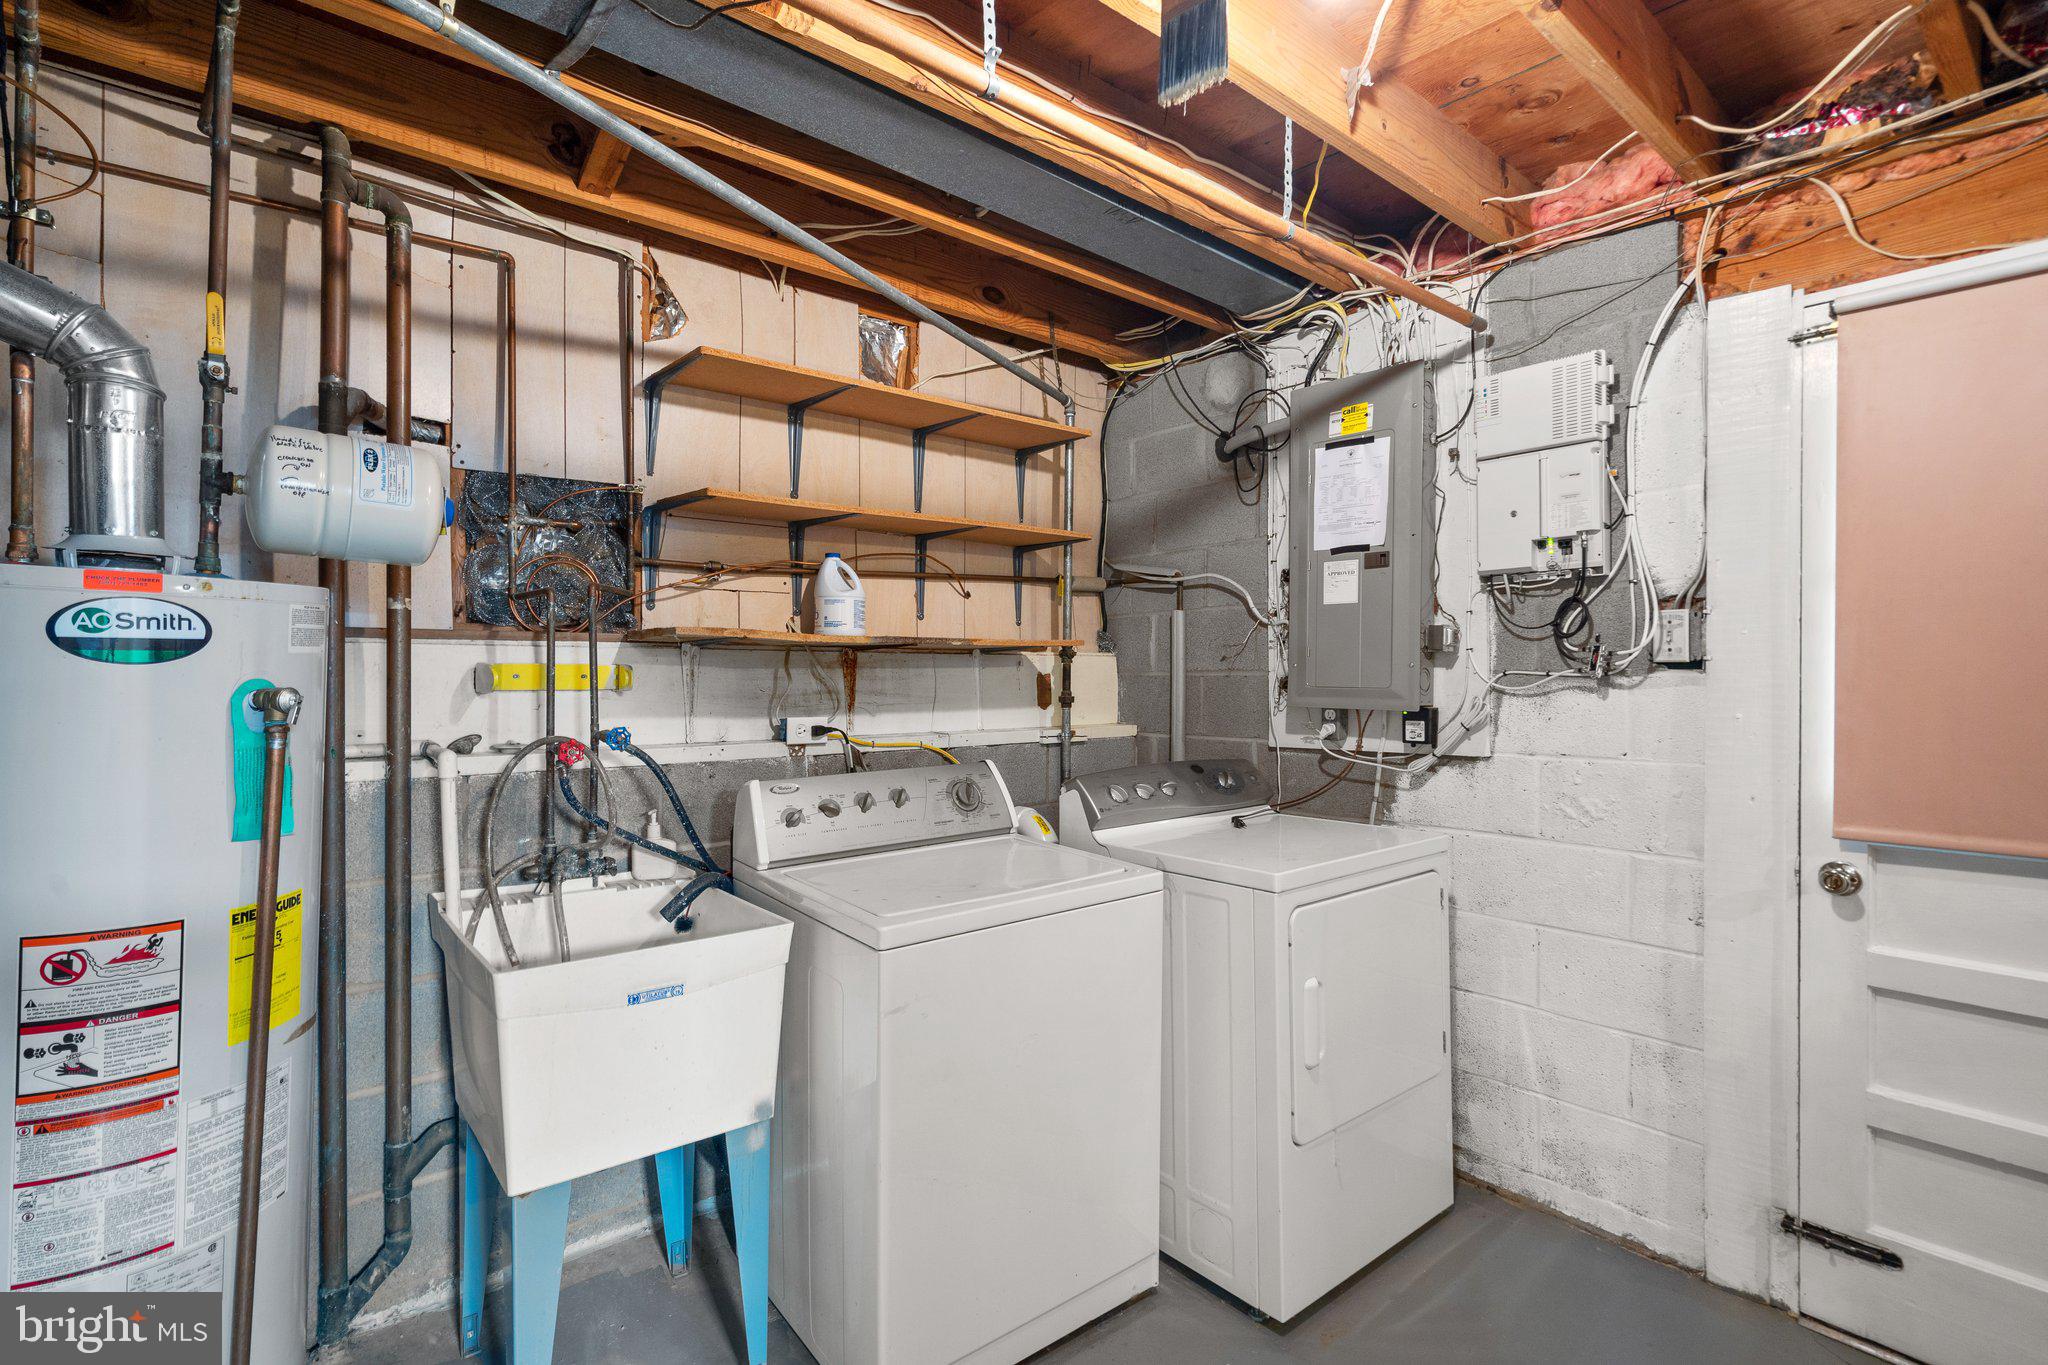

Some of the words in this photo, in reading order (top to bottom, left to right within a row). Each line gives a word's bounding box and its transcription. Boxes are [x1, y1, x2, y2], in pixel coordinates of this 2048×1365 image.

[115, 612, 193, 631] Smith
[97, 929, 142, 941] WARNING
[98, 1013, 139, 1025] DANGER
[61, 1088, 95, 1099] WARNING
[99, 1078, 148, 1091] ADVERTENCIA
